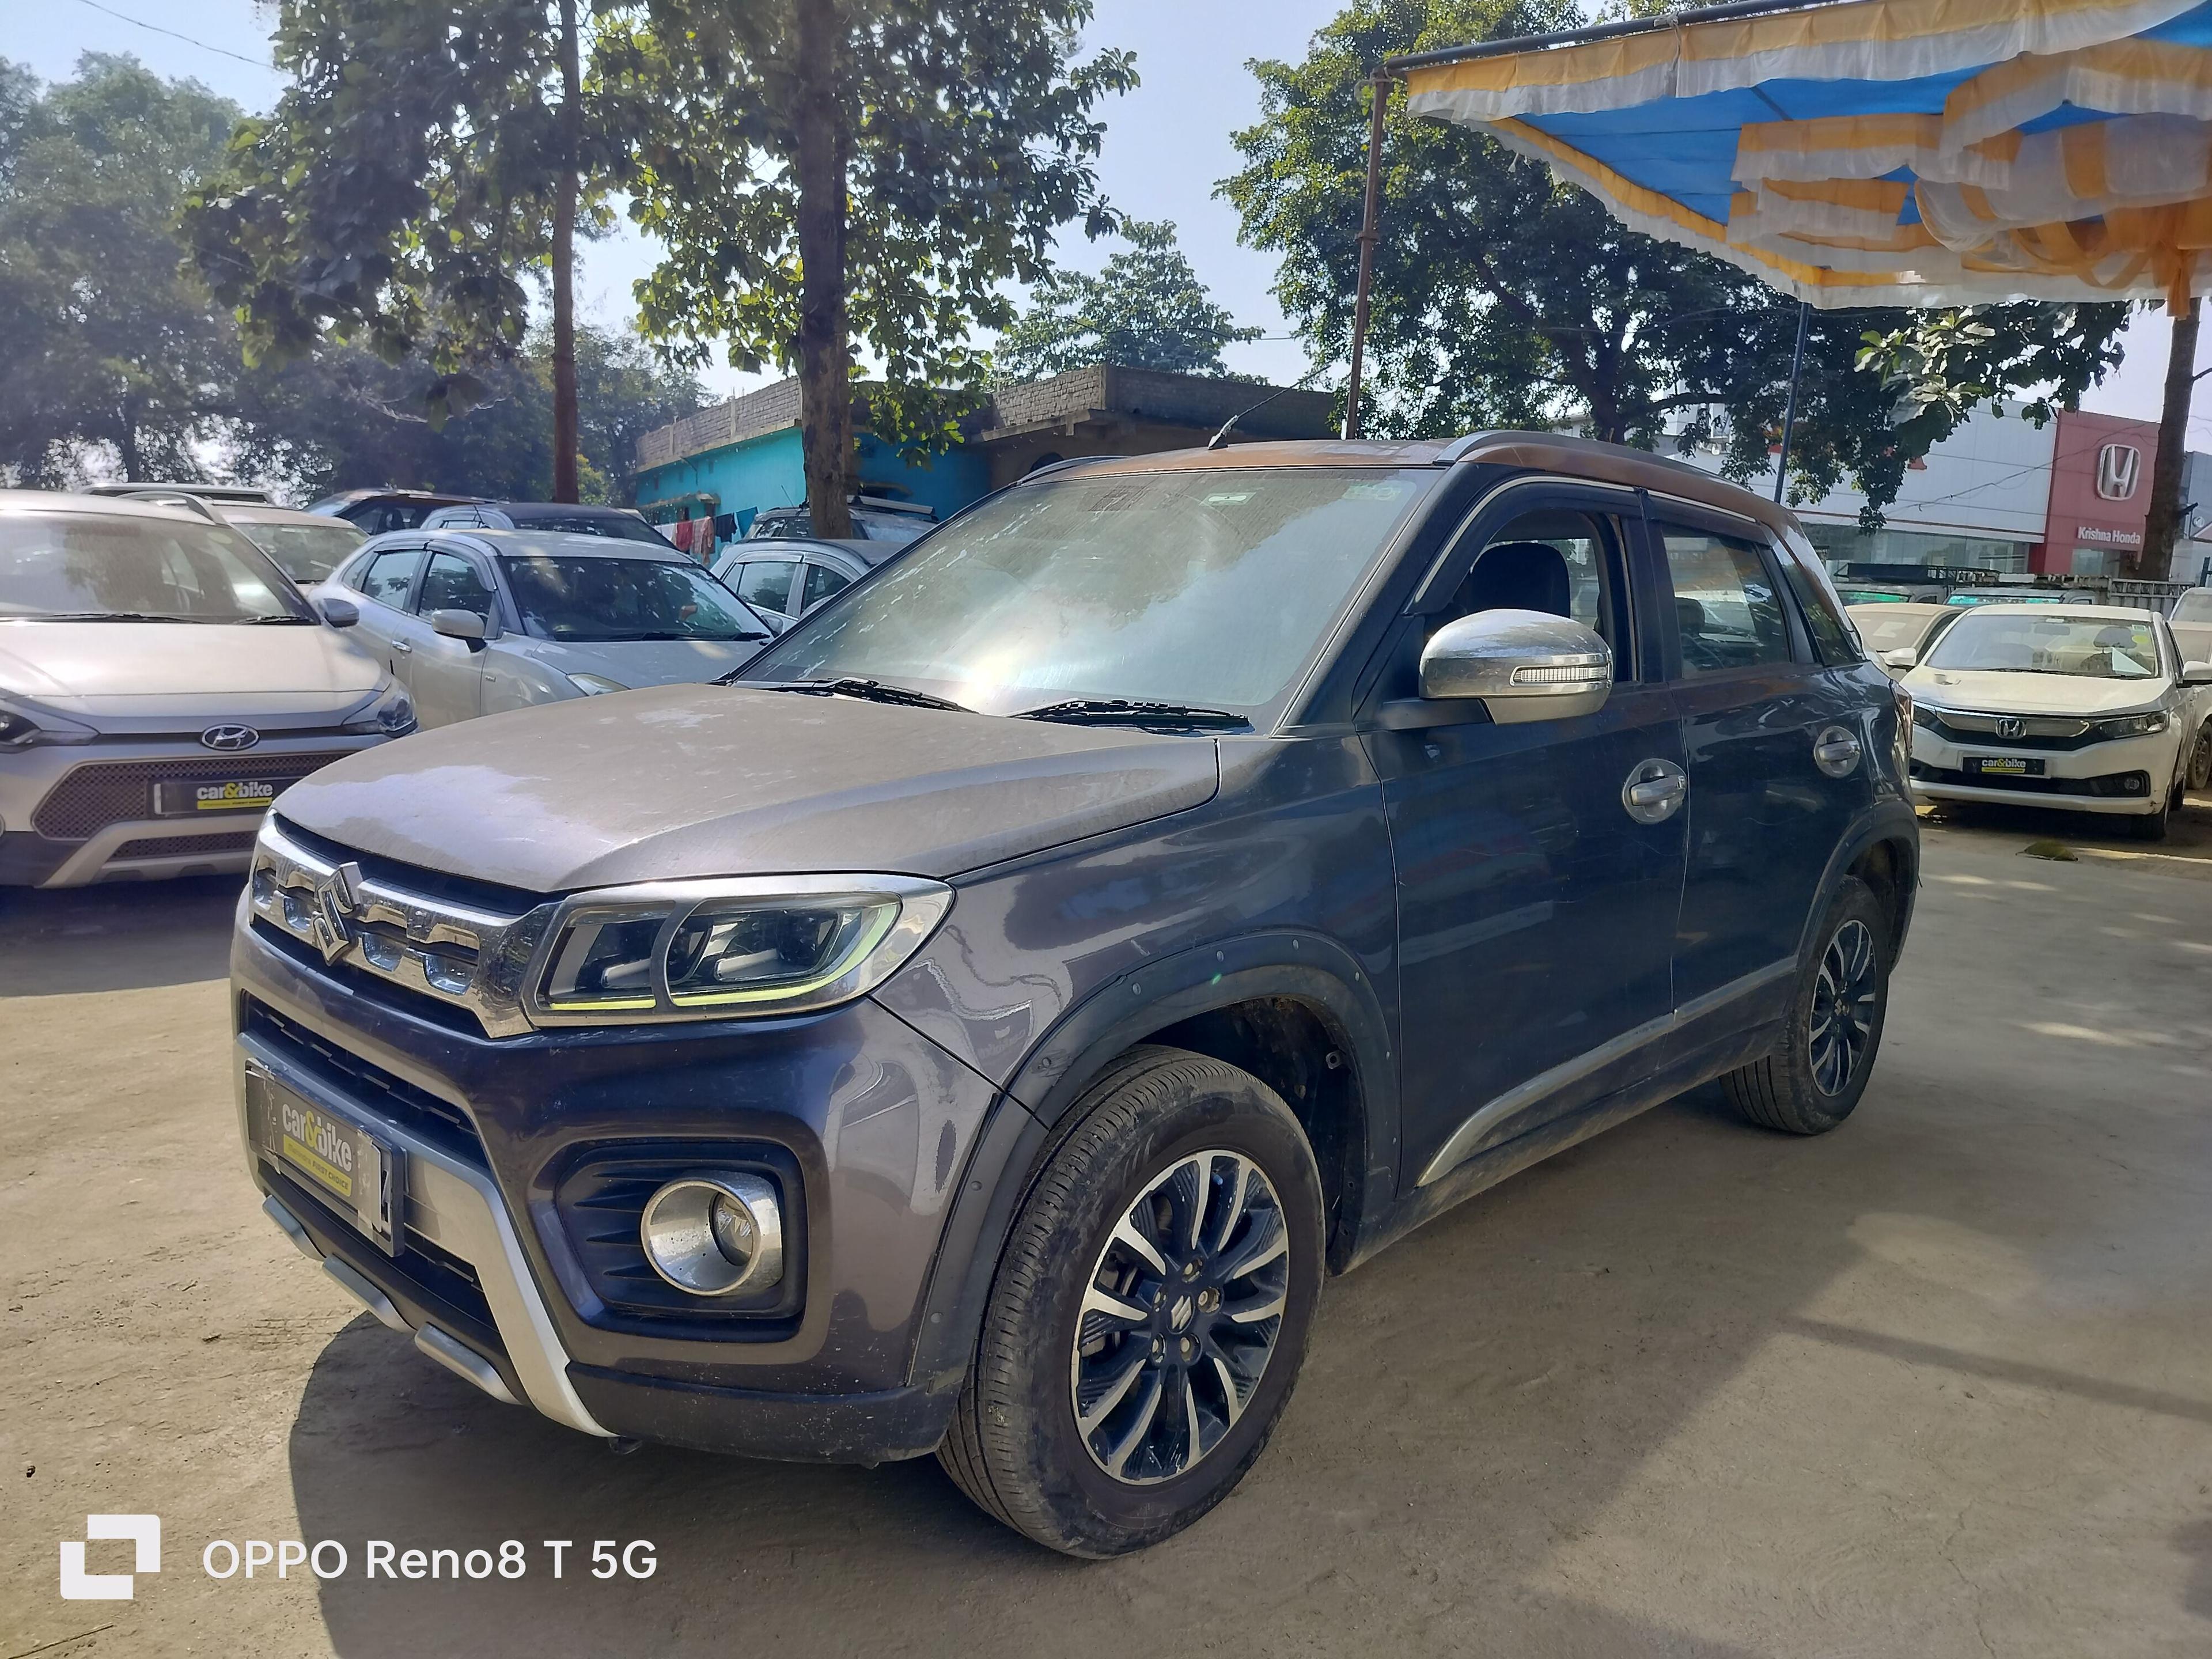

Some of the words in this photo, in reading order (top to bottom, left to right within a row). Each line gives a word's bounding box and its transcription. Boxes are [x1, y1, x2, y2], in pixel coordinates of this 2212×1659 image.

[2077, 527, 2111, 541] Krishna
[2112, 530, 2141, 544] Honda
[1982, 758, 2026, 768] car&bike
[196, 782, 273, 800] car&bike
[282, 1104, 353, 1172] car&bike
